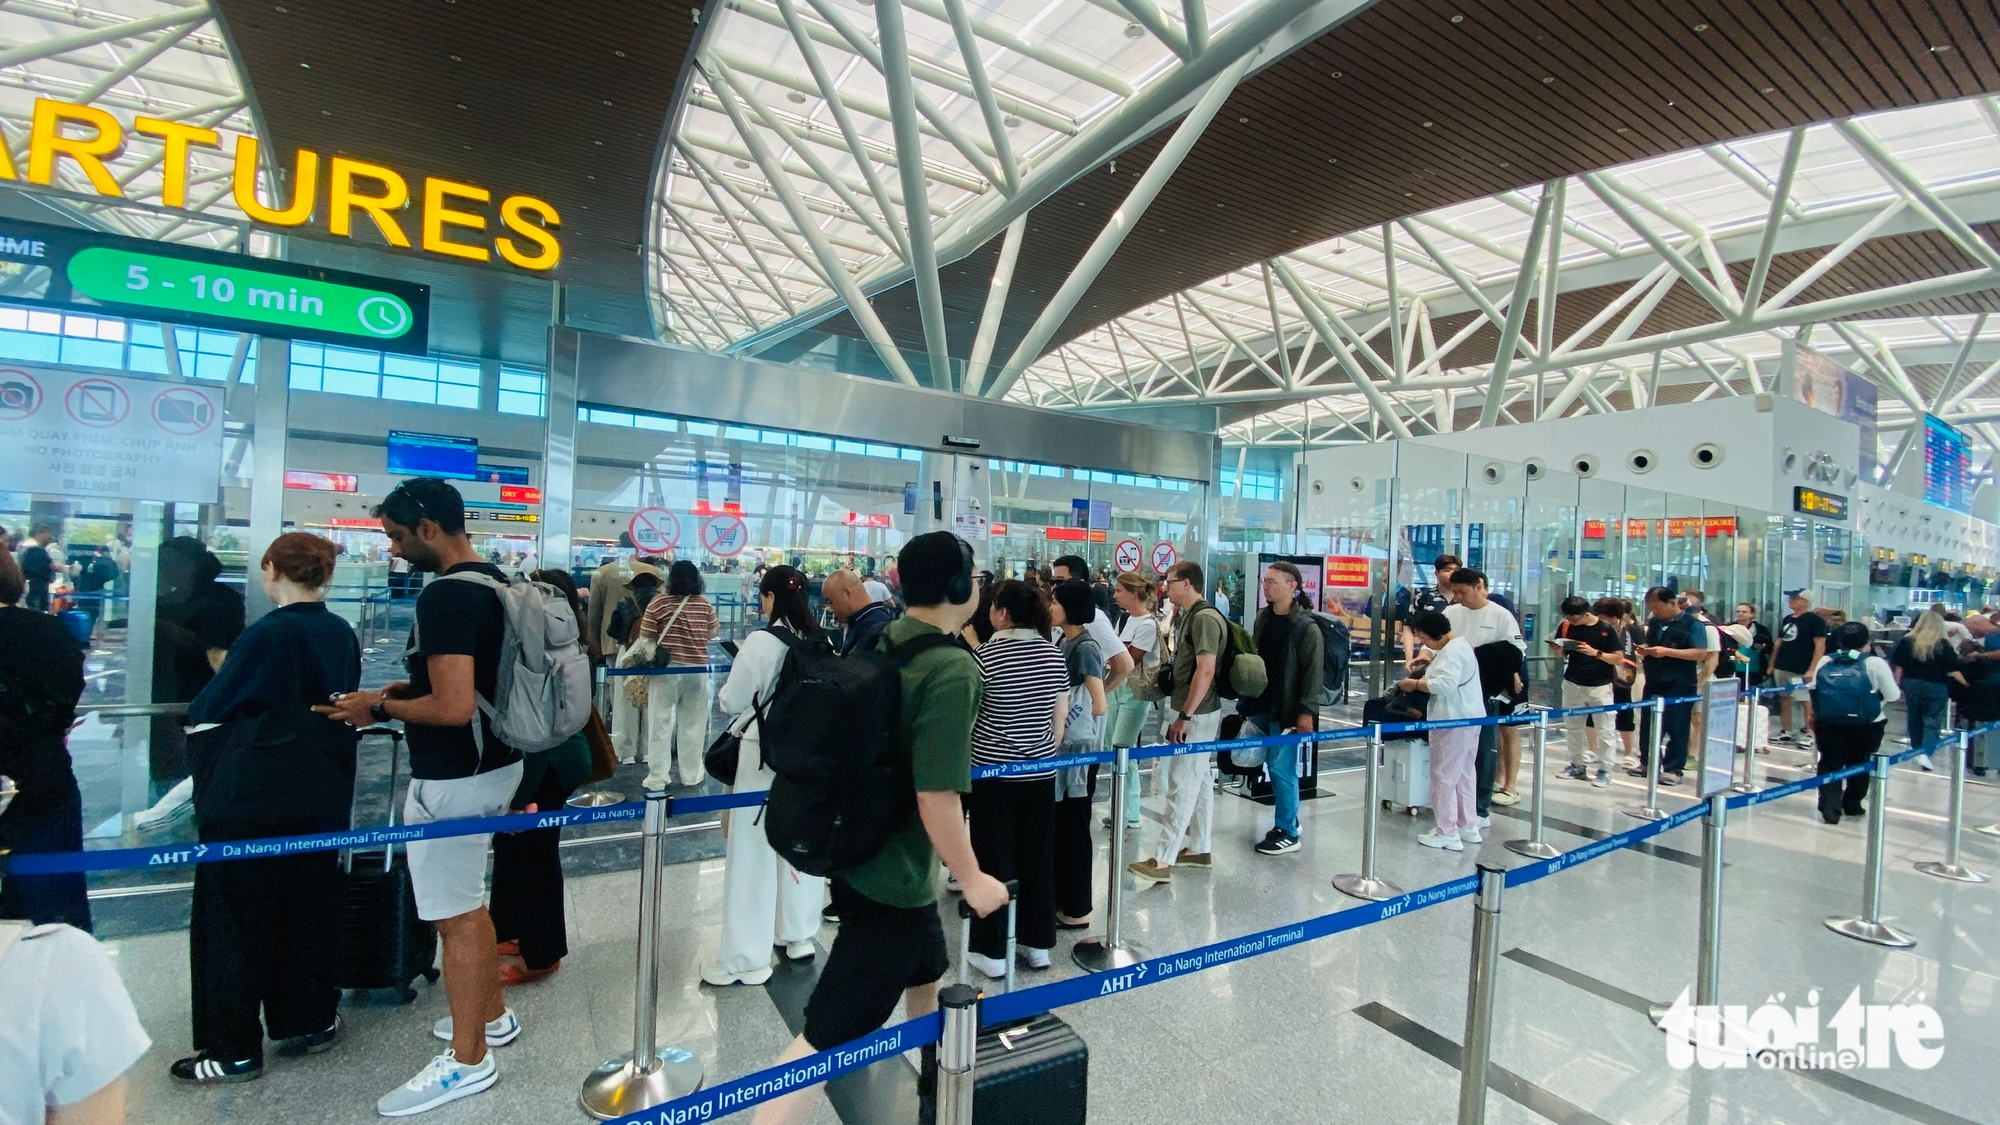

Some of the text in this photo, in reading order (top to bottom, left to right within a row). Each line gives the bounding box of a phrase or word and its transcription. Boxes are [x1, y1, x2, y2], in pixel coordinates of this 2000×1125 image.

[0, 98, 562, 271] RTURES
[126, 264, 149, 290] 5
[190, 275, 235, 302] 10
[247, 286, 324, 316] min
[28, 429, 69, 442] QUAY
[25, 445, 163, 464] NO PHOTOGRAPHY
[49, 461, 75, 474] 사진
[111, 465, 136, 478] 금지
[1173, 747, 1187, 755] AHT
[1217, 741, 1245, 749] International
[981, 768, 1000, 778] AHT
[1012, 764, 1022, 772] Da
[1022, 763, 1038, 772] Nang
[1039, 757, 1075, 769] International
[537, 815, 569, 828] AHT
[608, 807, 636, 820] Nang
[149, 828, 424, 865] AHT Da Nang International Terminal
[1548, 860, 1561, 874] AHT
[1380, 902, 1403, 919] AHT
[1417, 894, 1427, 905] Da
[1428, 890, 1446, 903] Nang
[1100, 927, 1304, 995] AHT Da Nang International Terminal
[660, 1031, 901, 1125] Nang International Terminal
